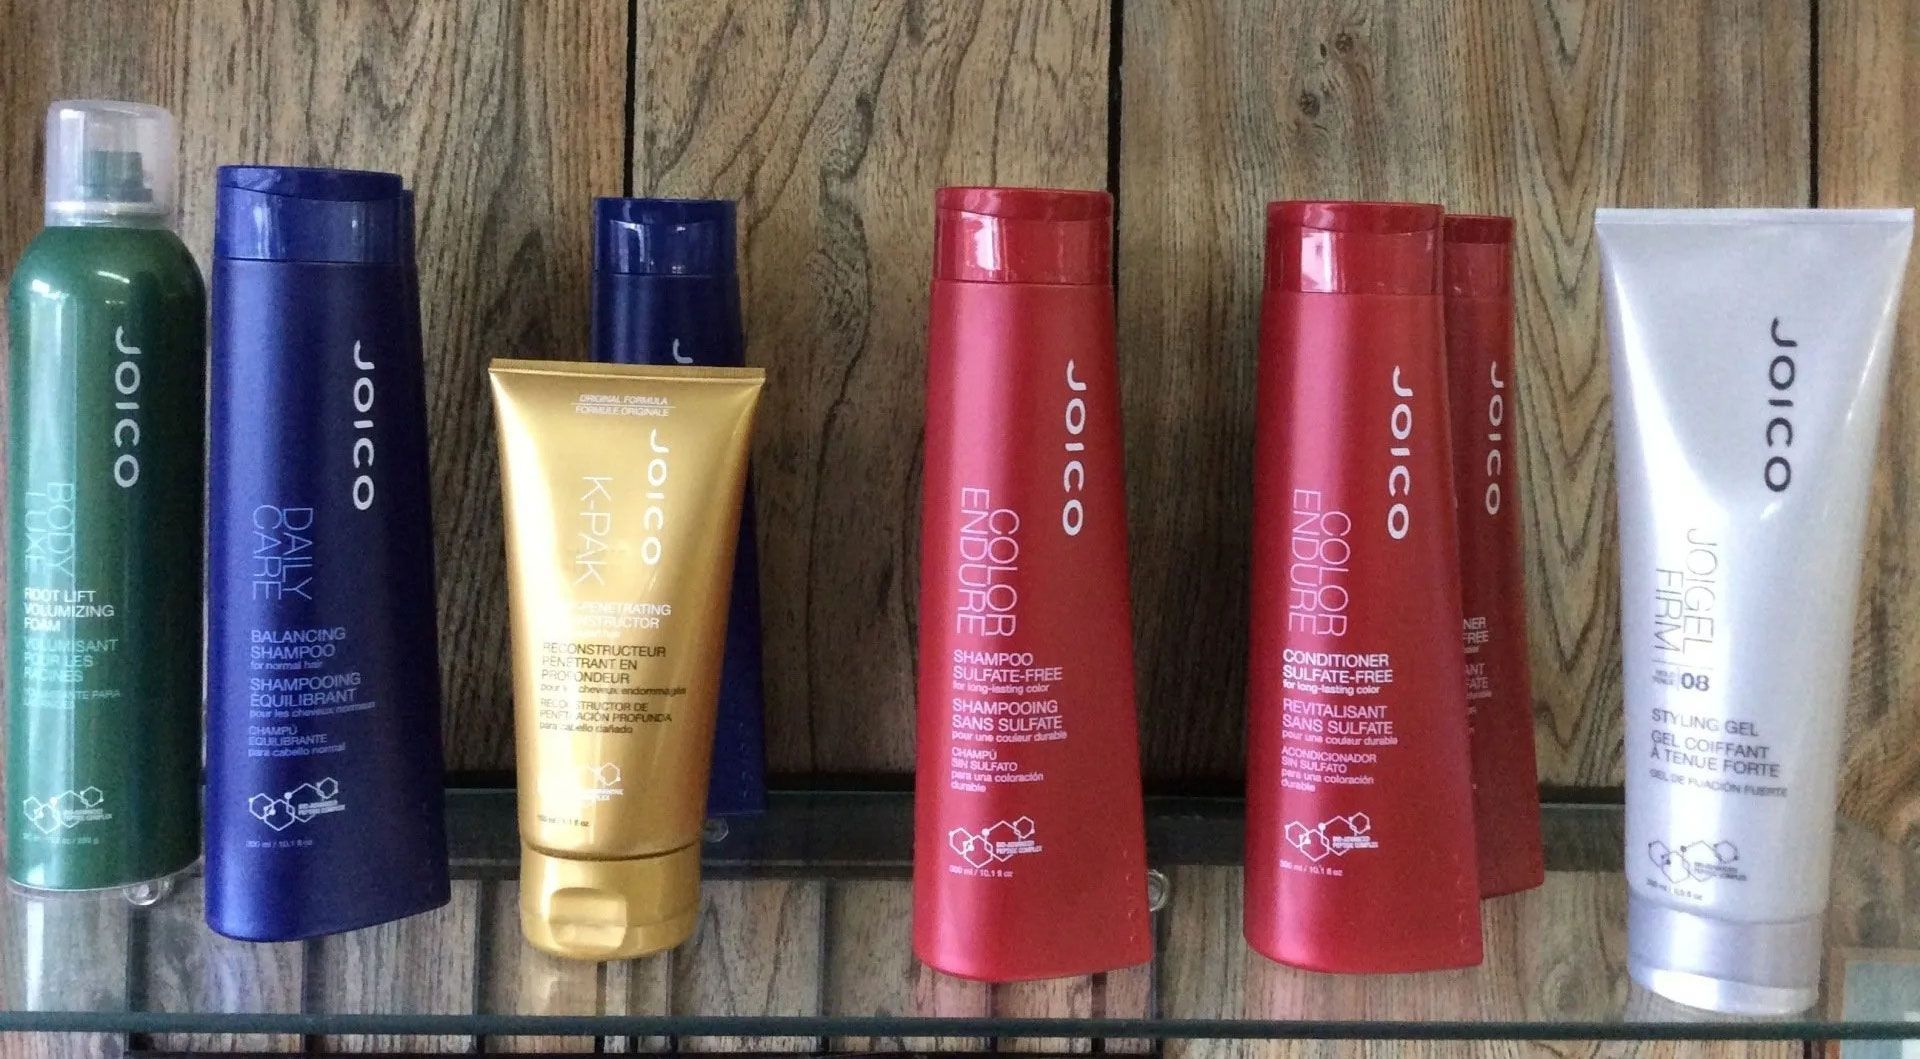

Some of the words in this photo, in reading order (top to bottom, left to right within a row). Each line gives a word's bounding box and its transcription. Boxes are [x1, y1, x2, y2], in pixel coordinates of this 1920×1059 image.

[114, 325, 142, 488] JOICO
[623, 395, 668, 405] FORMULA
[1764, 317, 1798, 492] JOICO
[575, 405, 619, 416] FORMULE
[620, 406, 669, 417] ORIGINALE
[353, 340, 375, 511] JOICO
[1485, 360, 1505, 515] JOICO
[1062, 359, 1087, 536] JOICO
[1387, 365, 1414, 540] JOICO
[641, 428, 669, 566] JOICO
[47, 482, 75, 577] BODY
[572, 476, 614, 587] K-PAK
[253, 504, 282, 600] CARE
[282, 507, 314, 600] DAILY
[956, 486, 990, 636] ENDURE
[1288, 488, 1322, 636] ENDURE
[985, 508, 1020, 637] COLOR
[1317, 511, 1351, 637] COLOR
[24, 587, 60, 603] ROOT
[64, 590, 96, 603] LIFT
[1683, 528, 1718, 655] JOIGEL
[24, 602, 115, 618] VOLUMIZING
[1654, 568, 1684, 652] FIRM
[24, 616, 60, 632] FOAM
[251, 626, 346, 643] BALANCING
[251, 643, 336, 660] SHAMPOO
[543, 641, 667, 658] RECONSTRUCTEUR
[953, 648, 1034, 667] SHAMPOO
[1283, 648, 1389, 668] CONDITIONER
[65, 654, 94, 668] LES
[619, 658, 638, 671] EN
[250, 671, 361, 692] SHAMPOOING
[953, 666, 1064, 683] SULFATE-FREE
[1282, 664, 1393, 684] SULFATE-FREE
[1681, 672, 1710, 692] 08
[952, 680, 965, 690] for
[967, 683, 1024, 695] long-lasting
[1025, 684, 1050, 693] color
[1282, 679, 1296, 689] for
[1297, 682, 1354, 696] long-lasting
[1356, 685, 1380, 695] color
[633, 702, 649, 712] DE
[952, 698, 1058, 716] SHAMPOOING
[1283, 698, 1388, 719] REVITALISANT
[612, 713, 673, 723] PROFUNDA
[952, 714, 995, 732] SANS
[998, 715, 1063, 732] SULFATE
[1282, 713, 1323, 733] SANS
[1327, 720, 1393, 735] SULFATE
[1652, 708, 1720, 732] STYLING
[1725, 720, 1759, 737] GEL
[952, 731, 972, 742] pour
[975, 734, 994, 742] une
[996, 733, 1032, 743] couleur
[1033, 730, 1067, 742] durable
[1282, 730, 1302, 740] pour
[1305, 734, 1323, 743] une
[1325, 736, 1362, 745] couleur
[1364, 736, 1398, 745] durable
[1651, 729, 1680, 748] GEL
[1685, 737, 1769, 759] COIFFANT
[1281, 746, 1377, 763] ACONDICIONADOR
[1664, 749, 1718, 771] TENUE
[1723, 759, 1780, 778] FORTE
[951, 758, 968, 770] SIN
[970, 761, 1018, 772] SULFATO
[1281, 755, 1297, 768] SIN
[1300, 760, 1347, 773] SULFATO
[951, 770, 972, 781] para
[974, 773, 992, 782] una
[994, 771, 1044, 783] coloración
[1281, 768, 1301, 779] para
[1304, 773, 1322, 782] una
[1649, 768, 1668, 782] GEL
[950, 781, 986, 793] durable
[1281, 779, 1315, 792] durable
